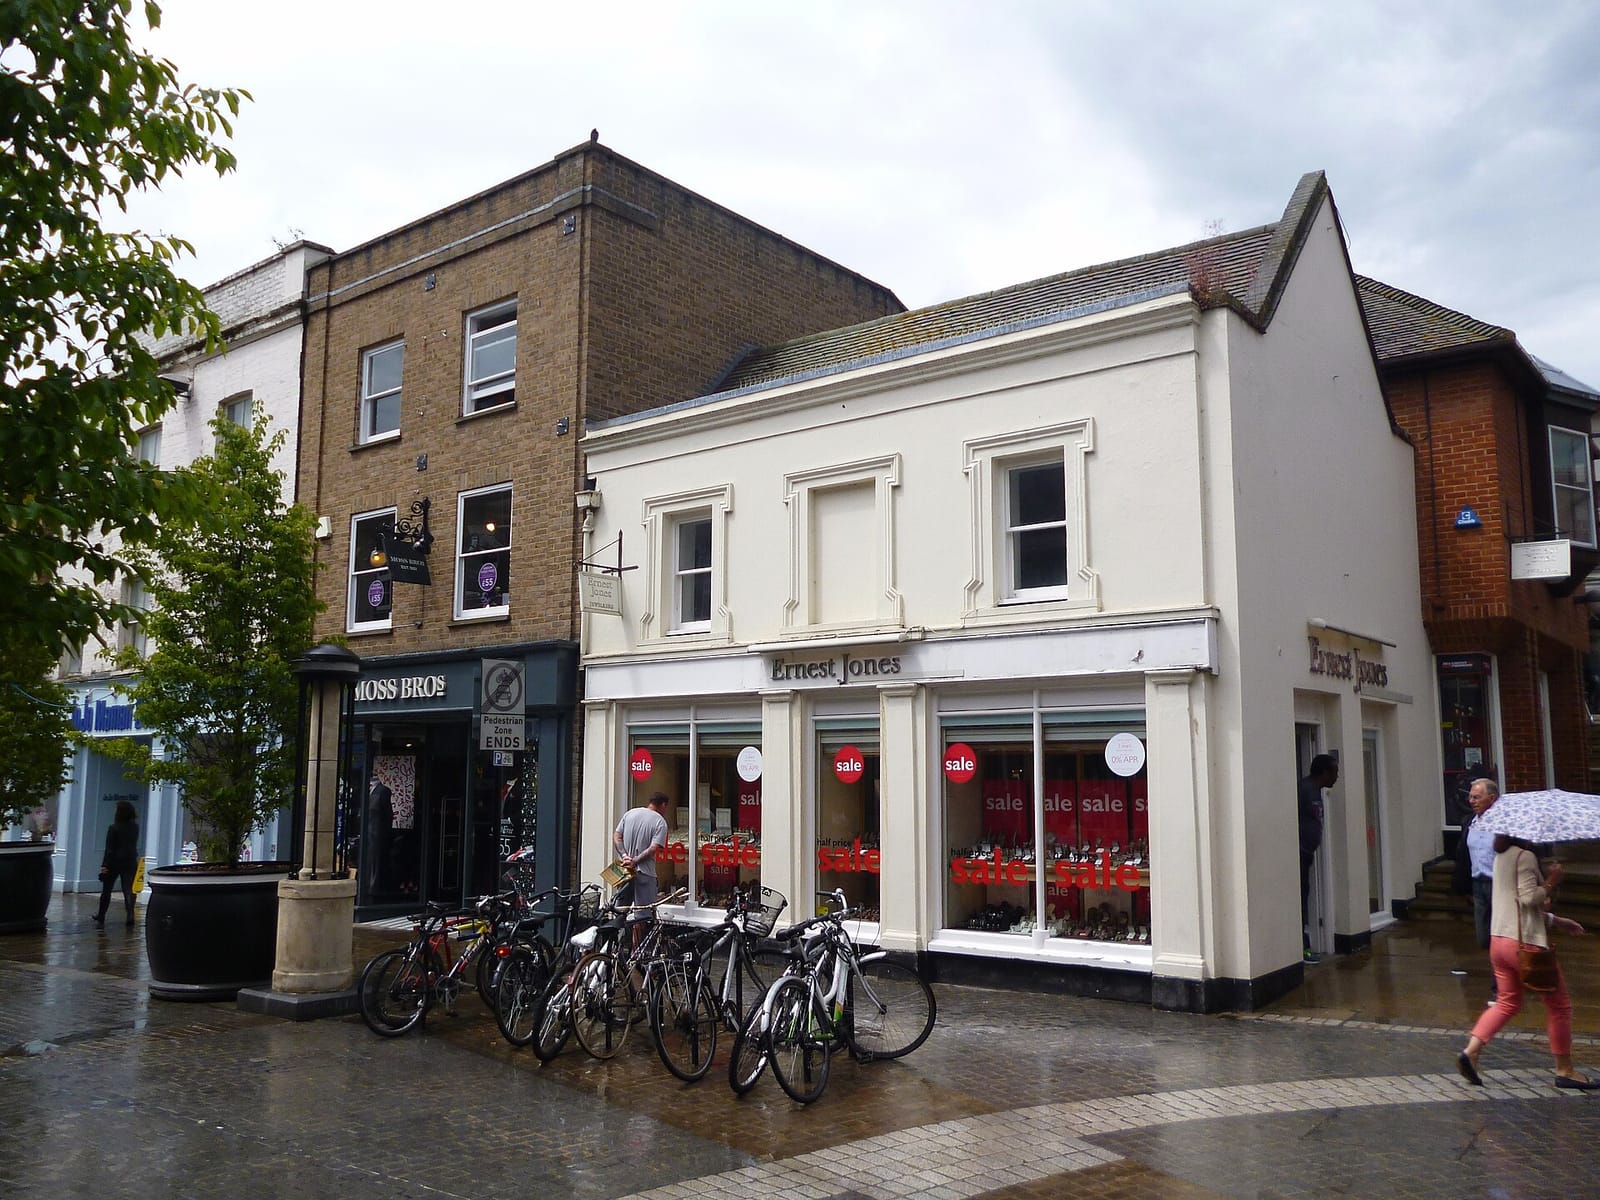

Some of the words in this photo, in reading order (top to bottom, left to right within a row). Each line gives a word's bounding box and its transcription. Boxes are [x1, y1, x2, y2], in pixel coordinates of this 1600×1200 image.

[770, 658, 836, 681] Ernest
[837, 653, 901, 685] Jones
[1308, 636, 1353, 680] Ernest
[1353, 648, 1388, 693] Jones
[483, 716, 523, 725] Pedestrian
[494, 726, 512, 735] Zone
[486, 736, 520, 748] ENDS
[495, 752, 502, 764] P
[631, 759, 652, 771] sale
[836, 757, 862, 772] sale
[945, 756, 974, 771] sale
[740, 789, 761, 806] sal
[986, 793, 1024, 811] sale
[1044, 793, 1072, 812] ale
[1082, 793, 1123, 812] sale
[817, 837, 831, 847] half
[701, 834, 759, 868] sale
[818, 836, 880, 874] sale
[710, 864, 729, 875] sale
[950, 847, 1029, 887] sale
[1054, 850, 1141, 892] sale
[1048, 884, 1069, 897] ale
